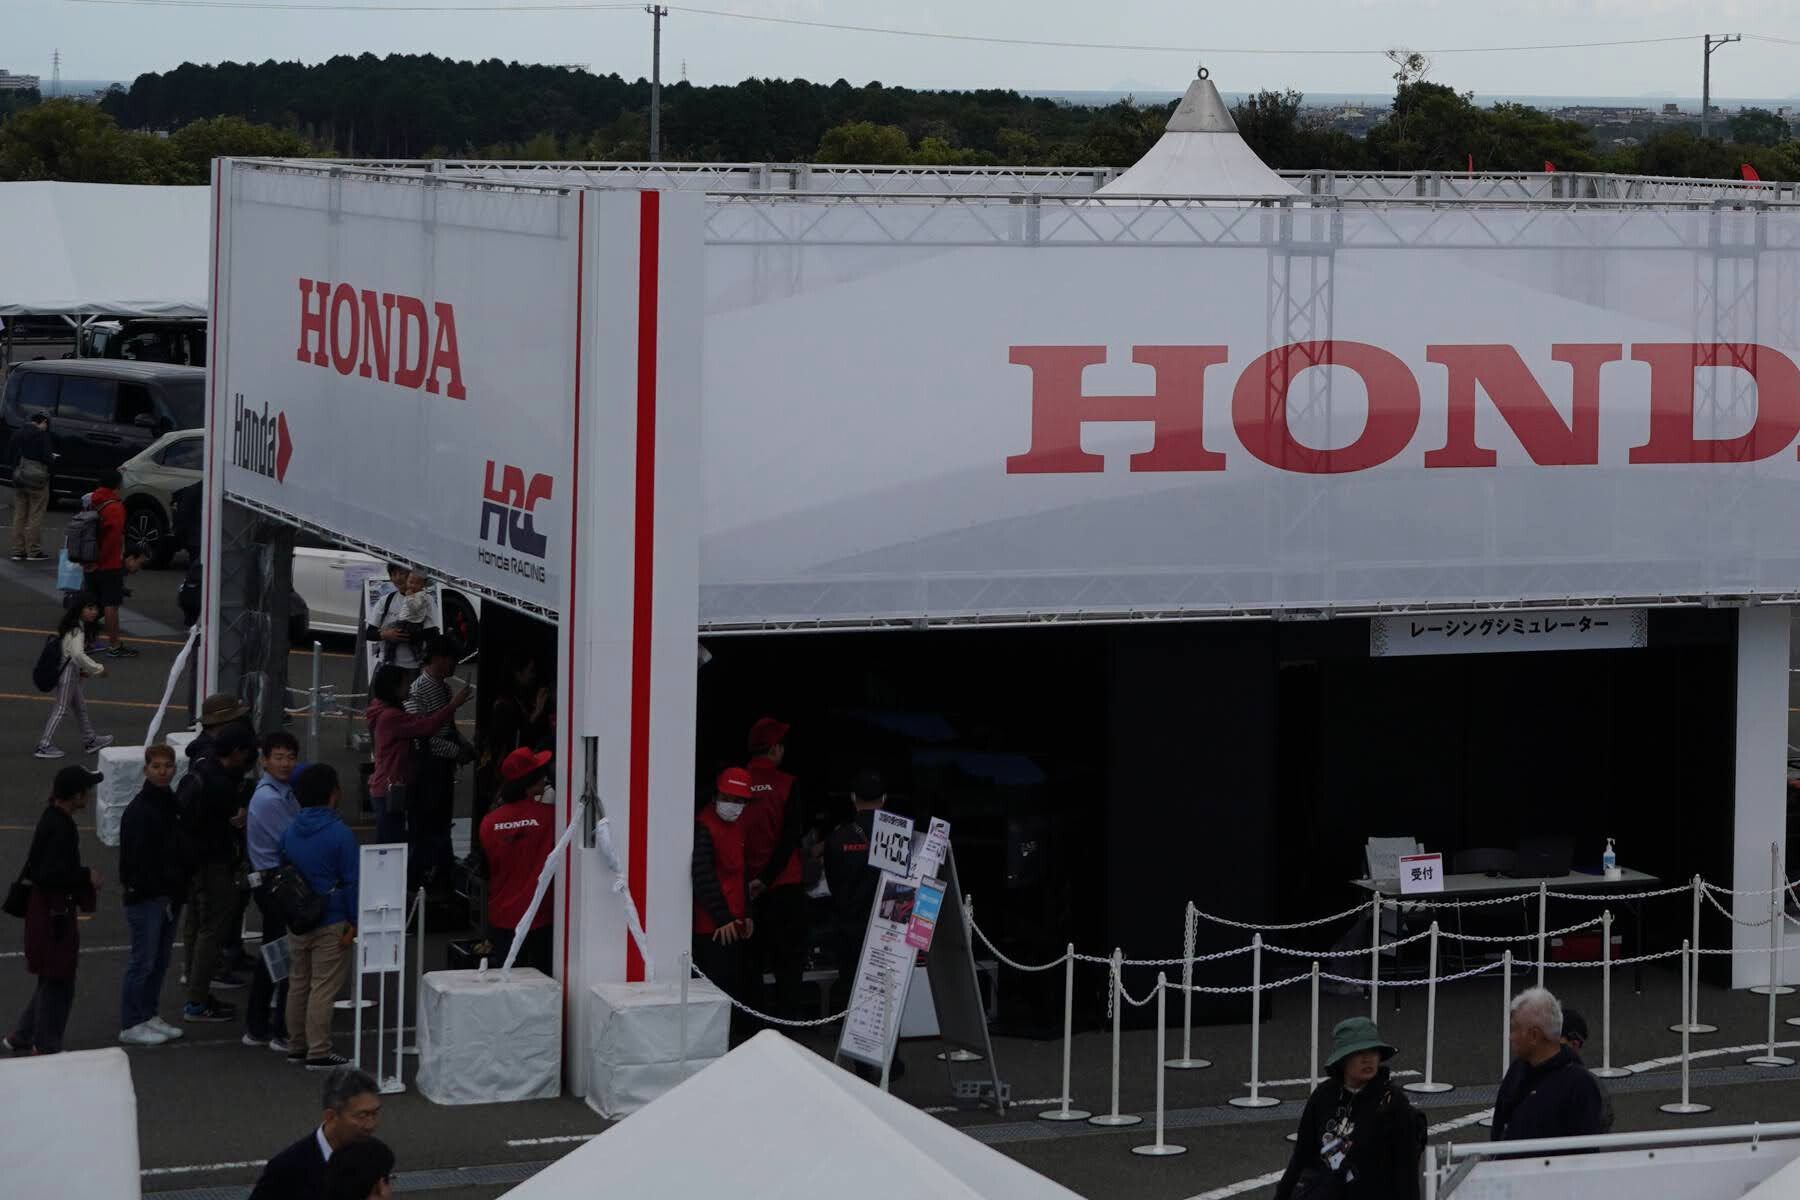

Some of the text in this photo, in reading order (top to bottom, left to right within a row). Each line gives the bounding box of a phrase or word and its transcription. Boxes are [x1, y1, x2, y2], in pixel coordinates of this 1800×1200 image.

[297, 278, 466, 400] HONDA
[232, 393, 277, 480] Honda
[1409, 615, 1610, 638] レーシングシミュレーター
[493, 818, 540, 831] HONDA
[1411, 866, 1433, 882] 受付
